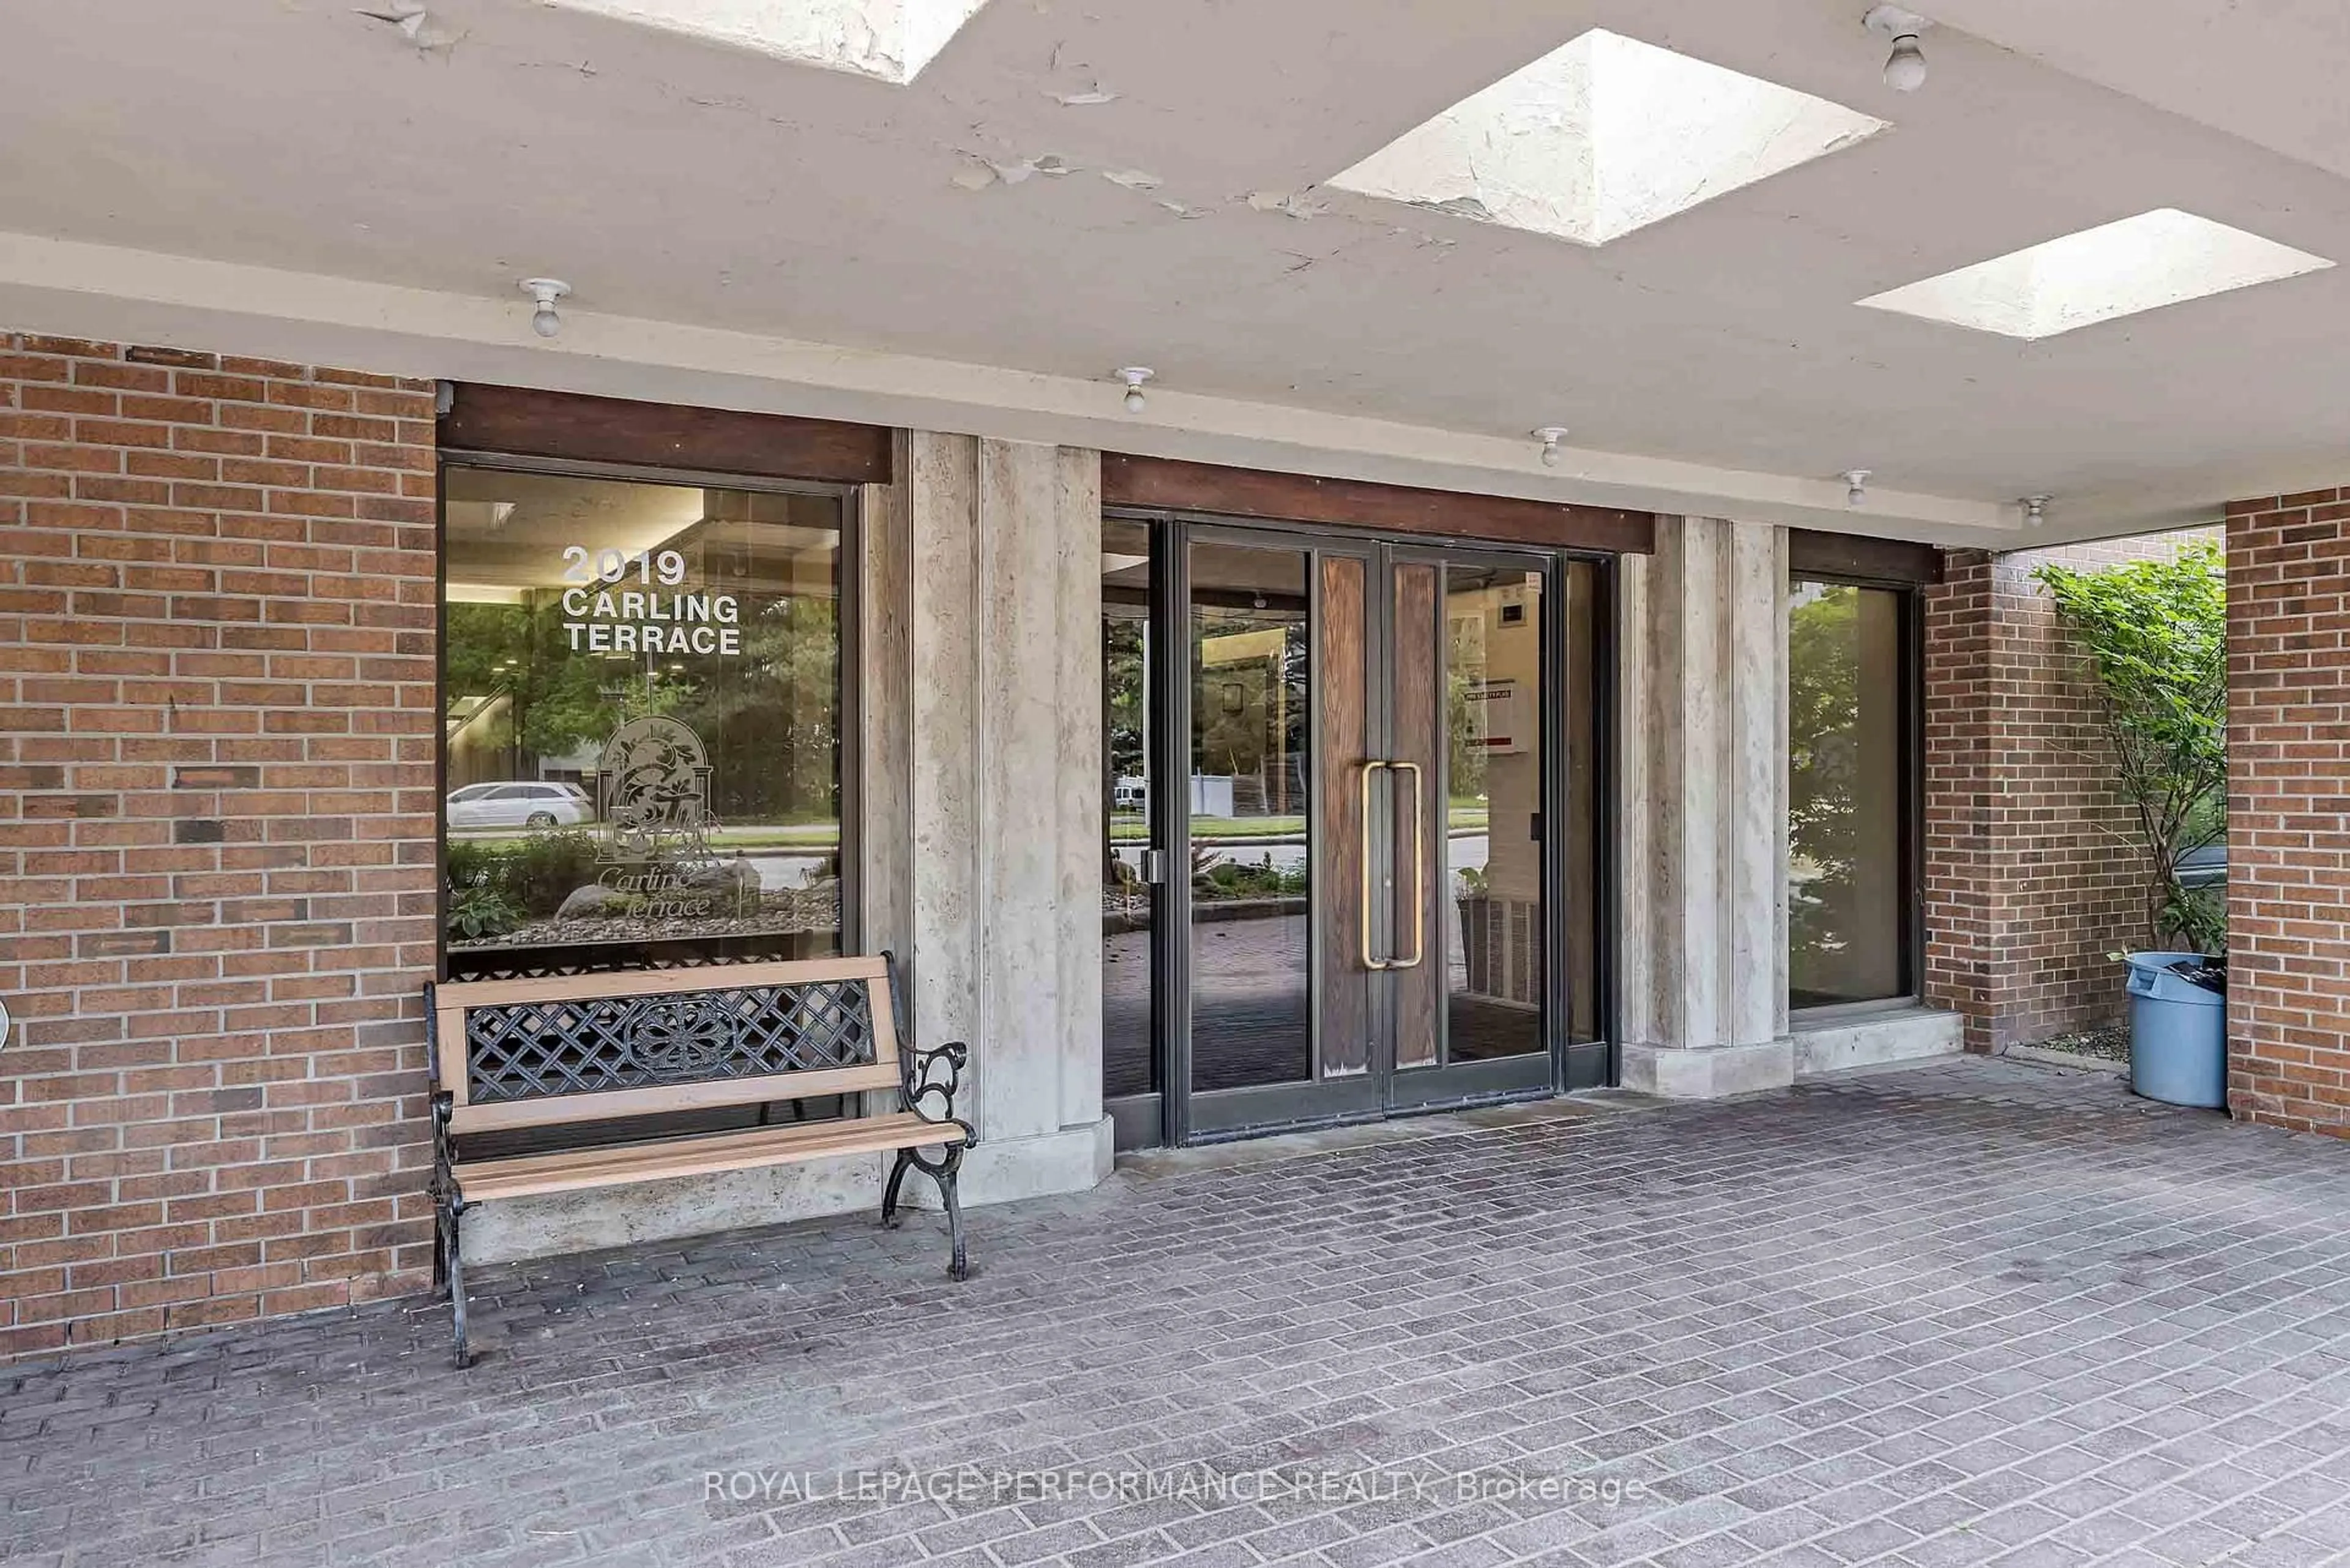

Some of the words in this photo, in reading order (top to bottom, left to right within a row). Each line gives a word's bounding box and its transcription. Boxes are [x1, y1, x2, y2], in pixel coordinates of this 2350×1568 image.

[562, 546, 685, 585] 2019
[562, 589, 738, 623] CARLING
[562, 623, 740, 655] TERRACE
